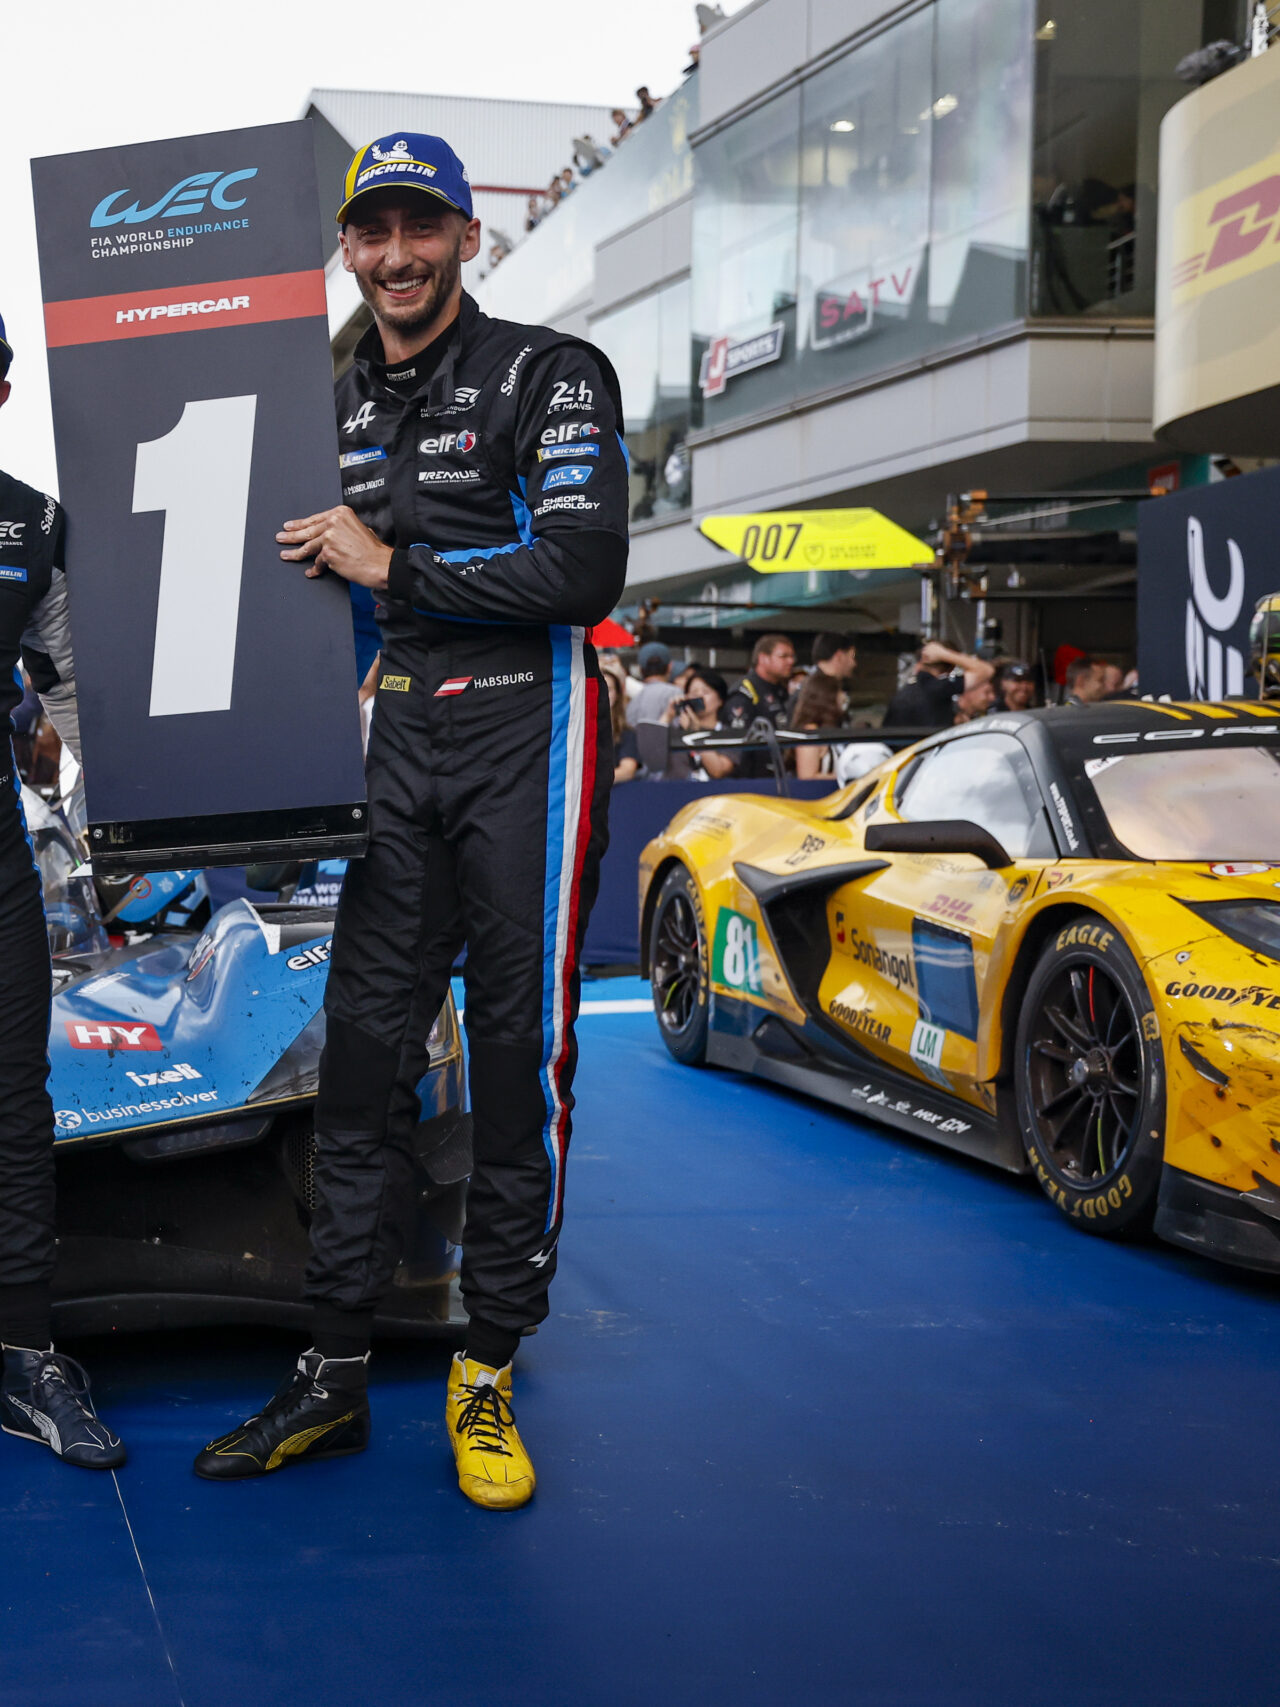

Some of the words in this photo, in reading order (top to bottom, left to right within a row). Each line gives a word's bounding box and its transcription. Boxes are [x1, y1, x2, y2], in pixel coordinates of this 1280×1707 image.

[357, 162, 436, 188] MICHELIN
[89, 167, 259, 229] WEC
[90, 236, 113, 248] FIA
[115, 229, 165, 246] WORLD
[167, 218, 250, 239] ENDURANCE
[91, 237, 195, 260] CHAMPIONSHIP
[115, 295, 251, 325] HYPERCAR
[562, 401, 592, 411] MANS
[419, 433, 457, 454] elf
[540, 423, 579, 445] elf
[552, 445, 595, 456] MICHELIN
[424, 469, 480, 481] REMUS
[549, 471, 568, 484] AVL
[533, 502, 601, 517] TECHNOLOGY
[542, 494, 586, 506] CHEOPS
[131, 394, 258, 717] 1
[741, 523, 803, 562] 007
[384, 676, 407, 691] Sabelt
[473, 671, 535, 689] HABSBURG
[1056, 923, 1115, 953] EAGLE
[286, 944, 329, 971] elf
[722, 914, 760, 992] 81
[850, 928, 915, 991] Sonangol
[1165, 981, 1280, 1010] GOODYE
[73, 1025, 147, 1045] HY
[916, 1026, 939, 1059] LM
[125, 1062, 203, 1088] ixell
[81, 1089, 219, 1124] businessolver
